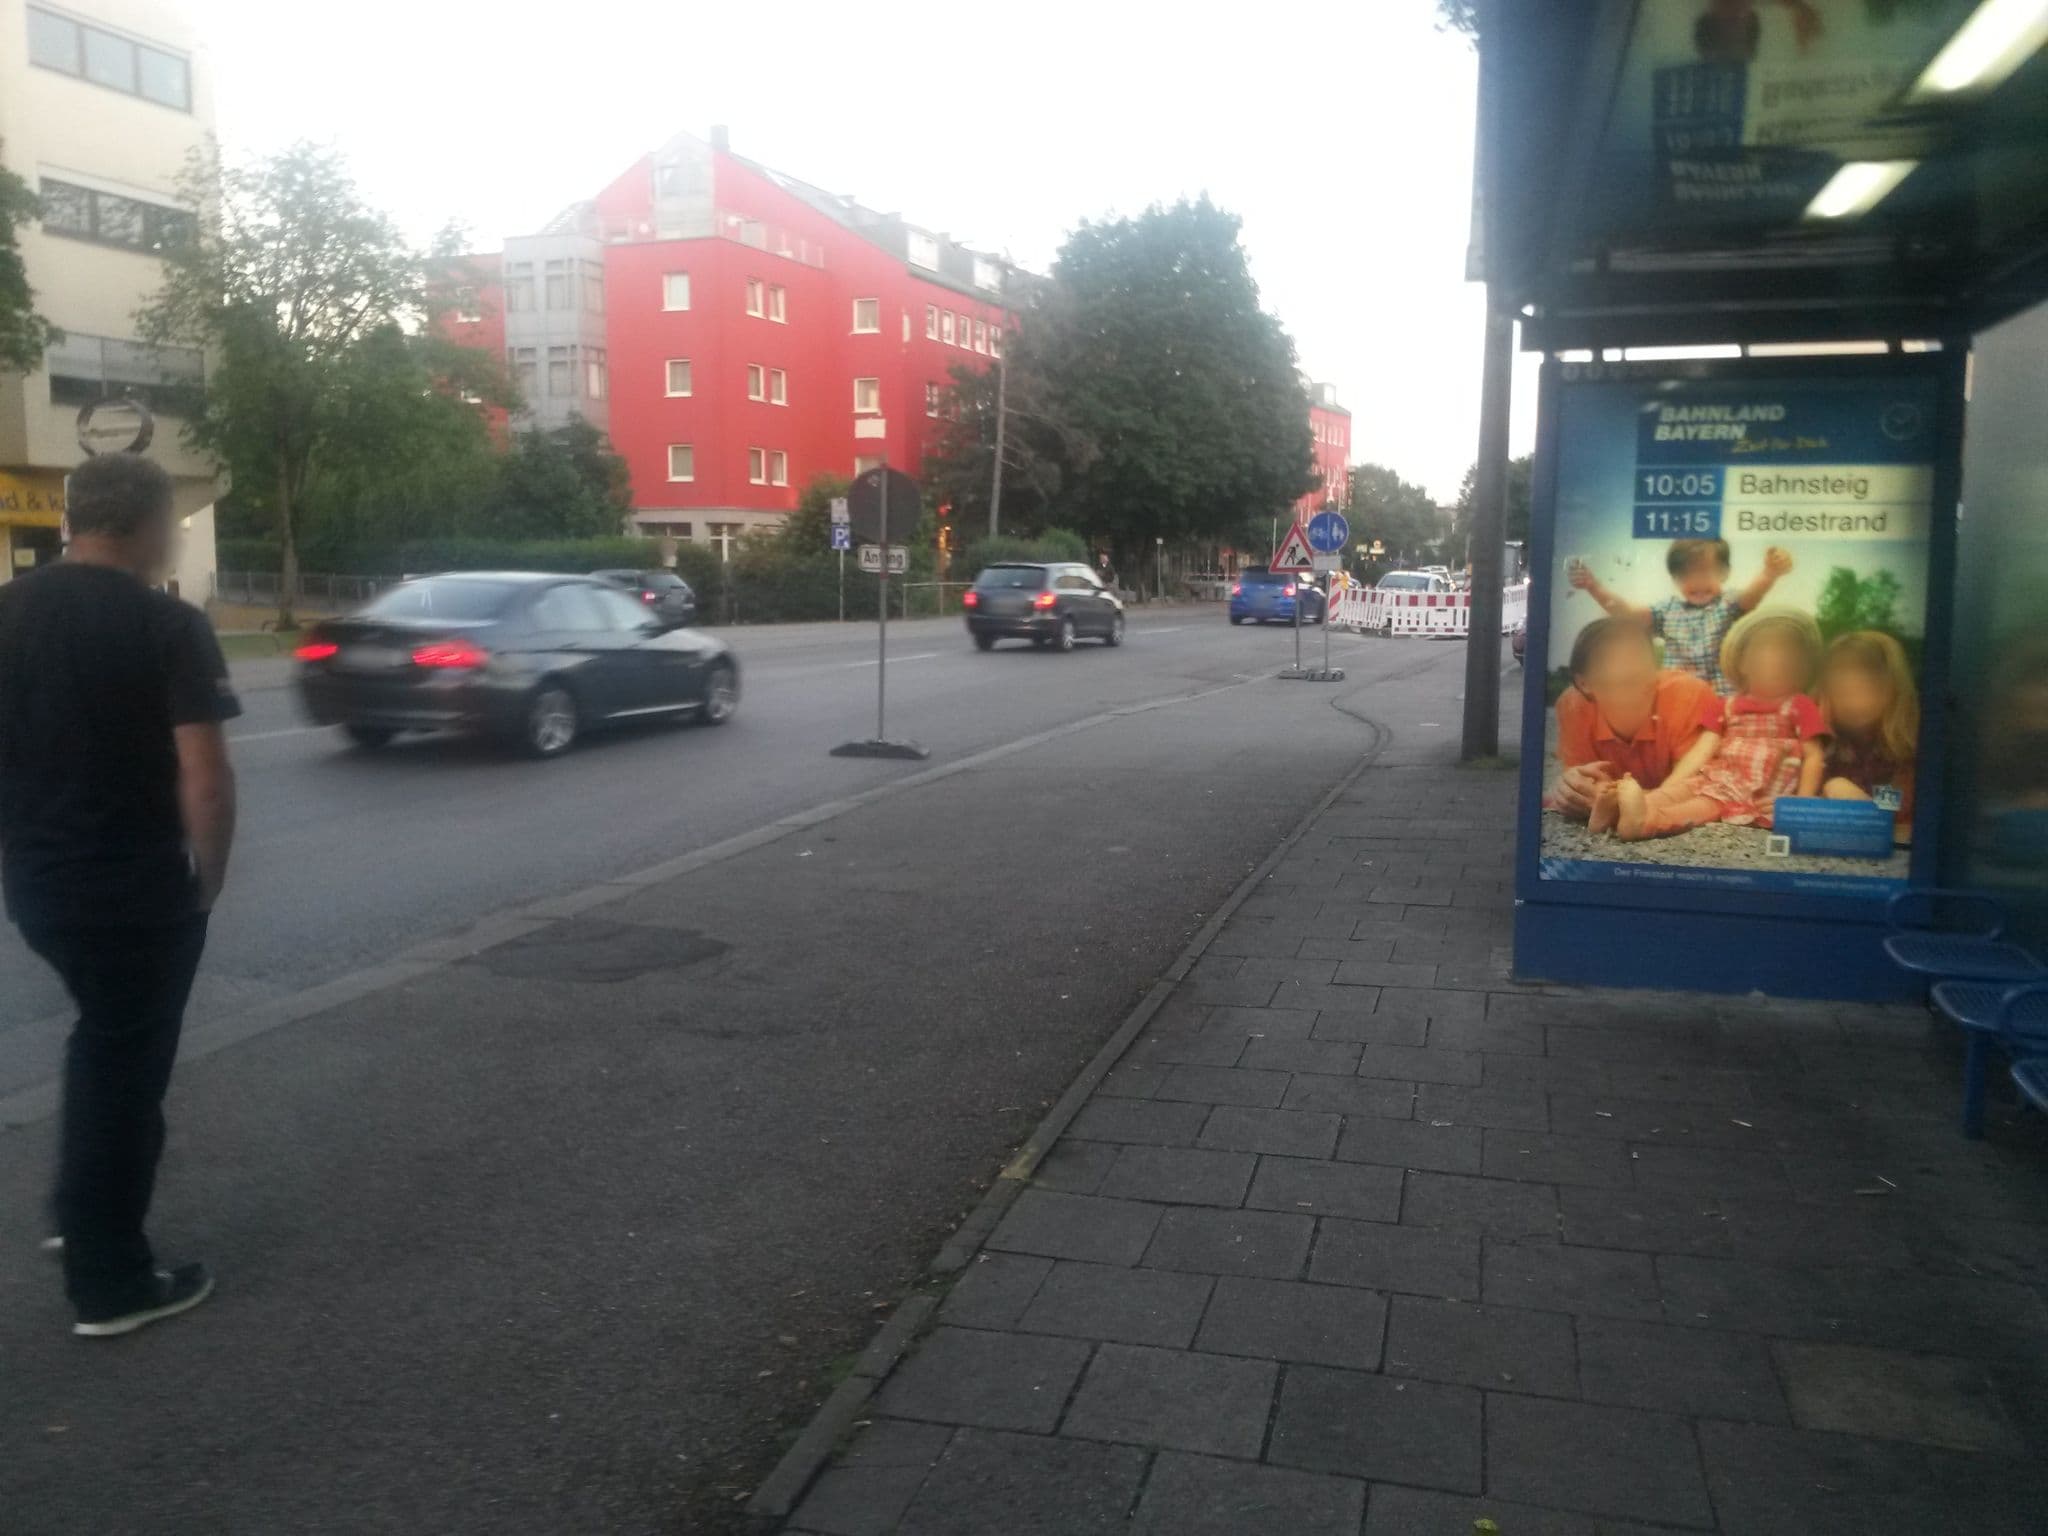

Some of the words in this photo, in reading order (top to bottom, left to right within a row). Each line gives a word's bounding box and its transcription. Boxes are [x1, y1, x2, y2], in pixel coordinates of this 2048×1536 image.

[1661, 406, 1784, 422] BAHNLAND
[1655, 424, 1746, 440] BAYERN
[1643, 474, 1716, 496] 10:05
[1740, 474, 1869, 499] Bahnsteig
[1644, 512, 1711, 533] 11:15
[1738, 510, 1887, 533] Badestrand
[835, 528, 848, 548] P
